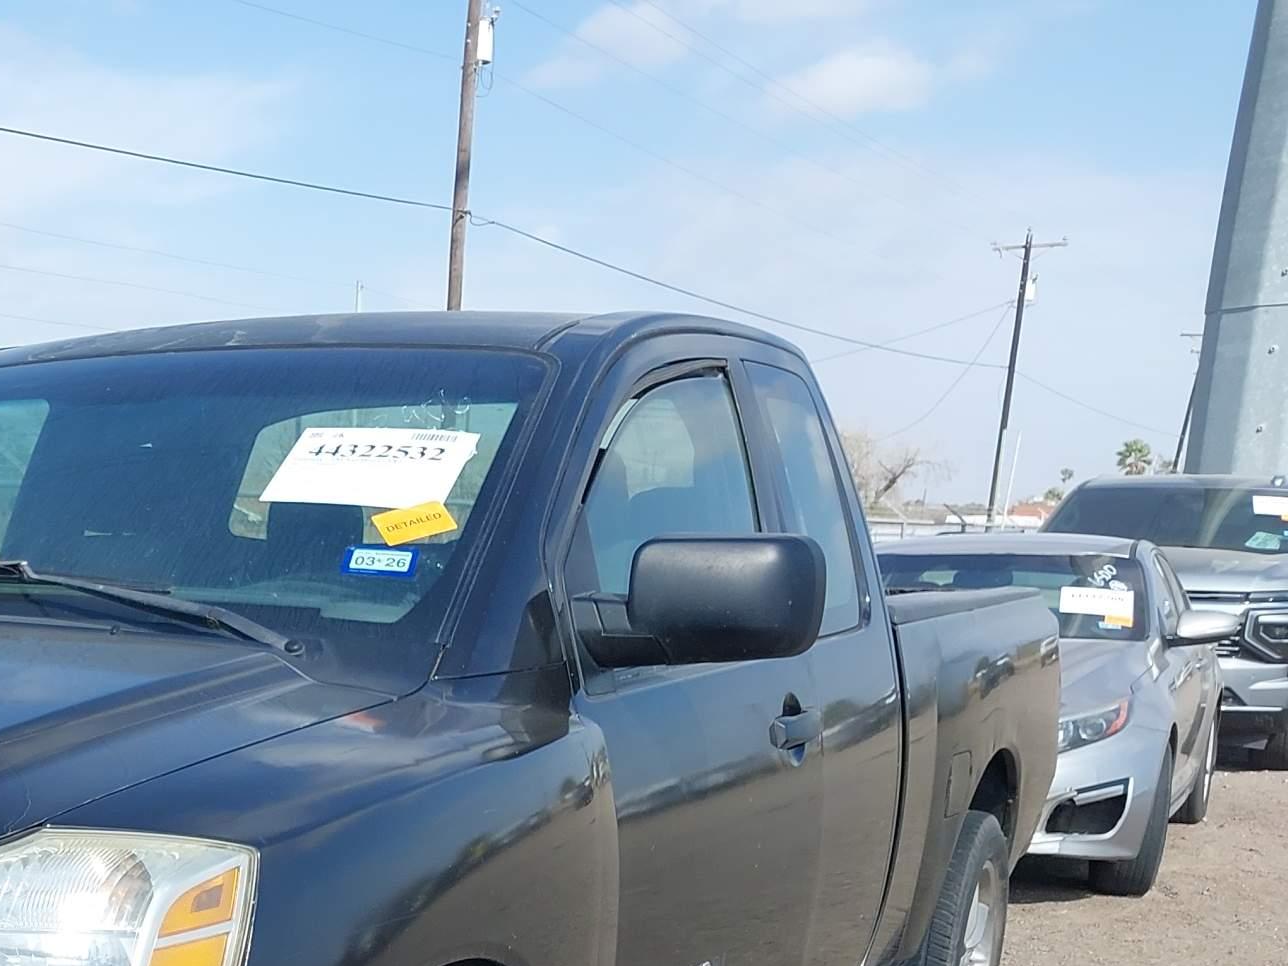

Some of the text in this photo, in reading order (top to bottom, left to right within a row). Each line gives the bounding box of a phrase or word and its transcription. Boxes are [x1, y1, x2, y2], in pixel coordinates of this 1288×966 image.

[308, 444, 446, 461] 44322532
[385, 512, 442, 532] DETAILED
[355, 556, 407, 567] 03 26
